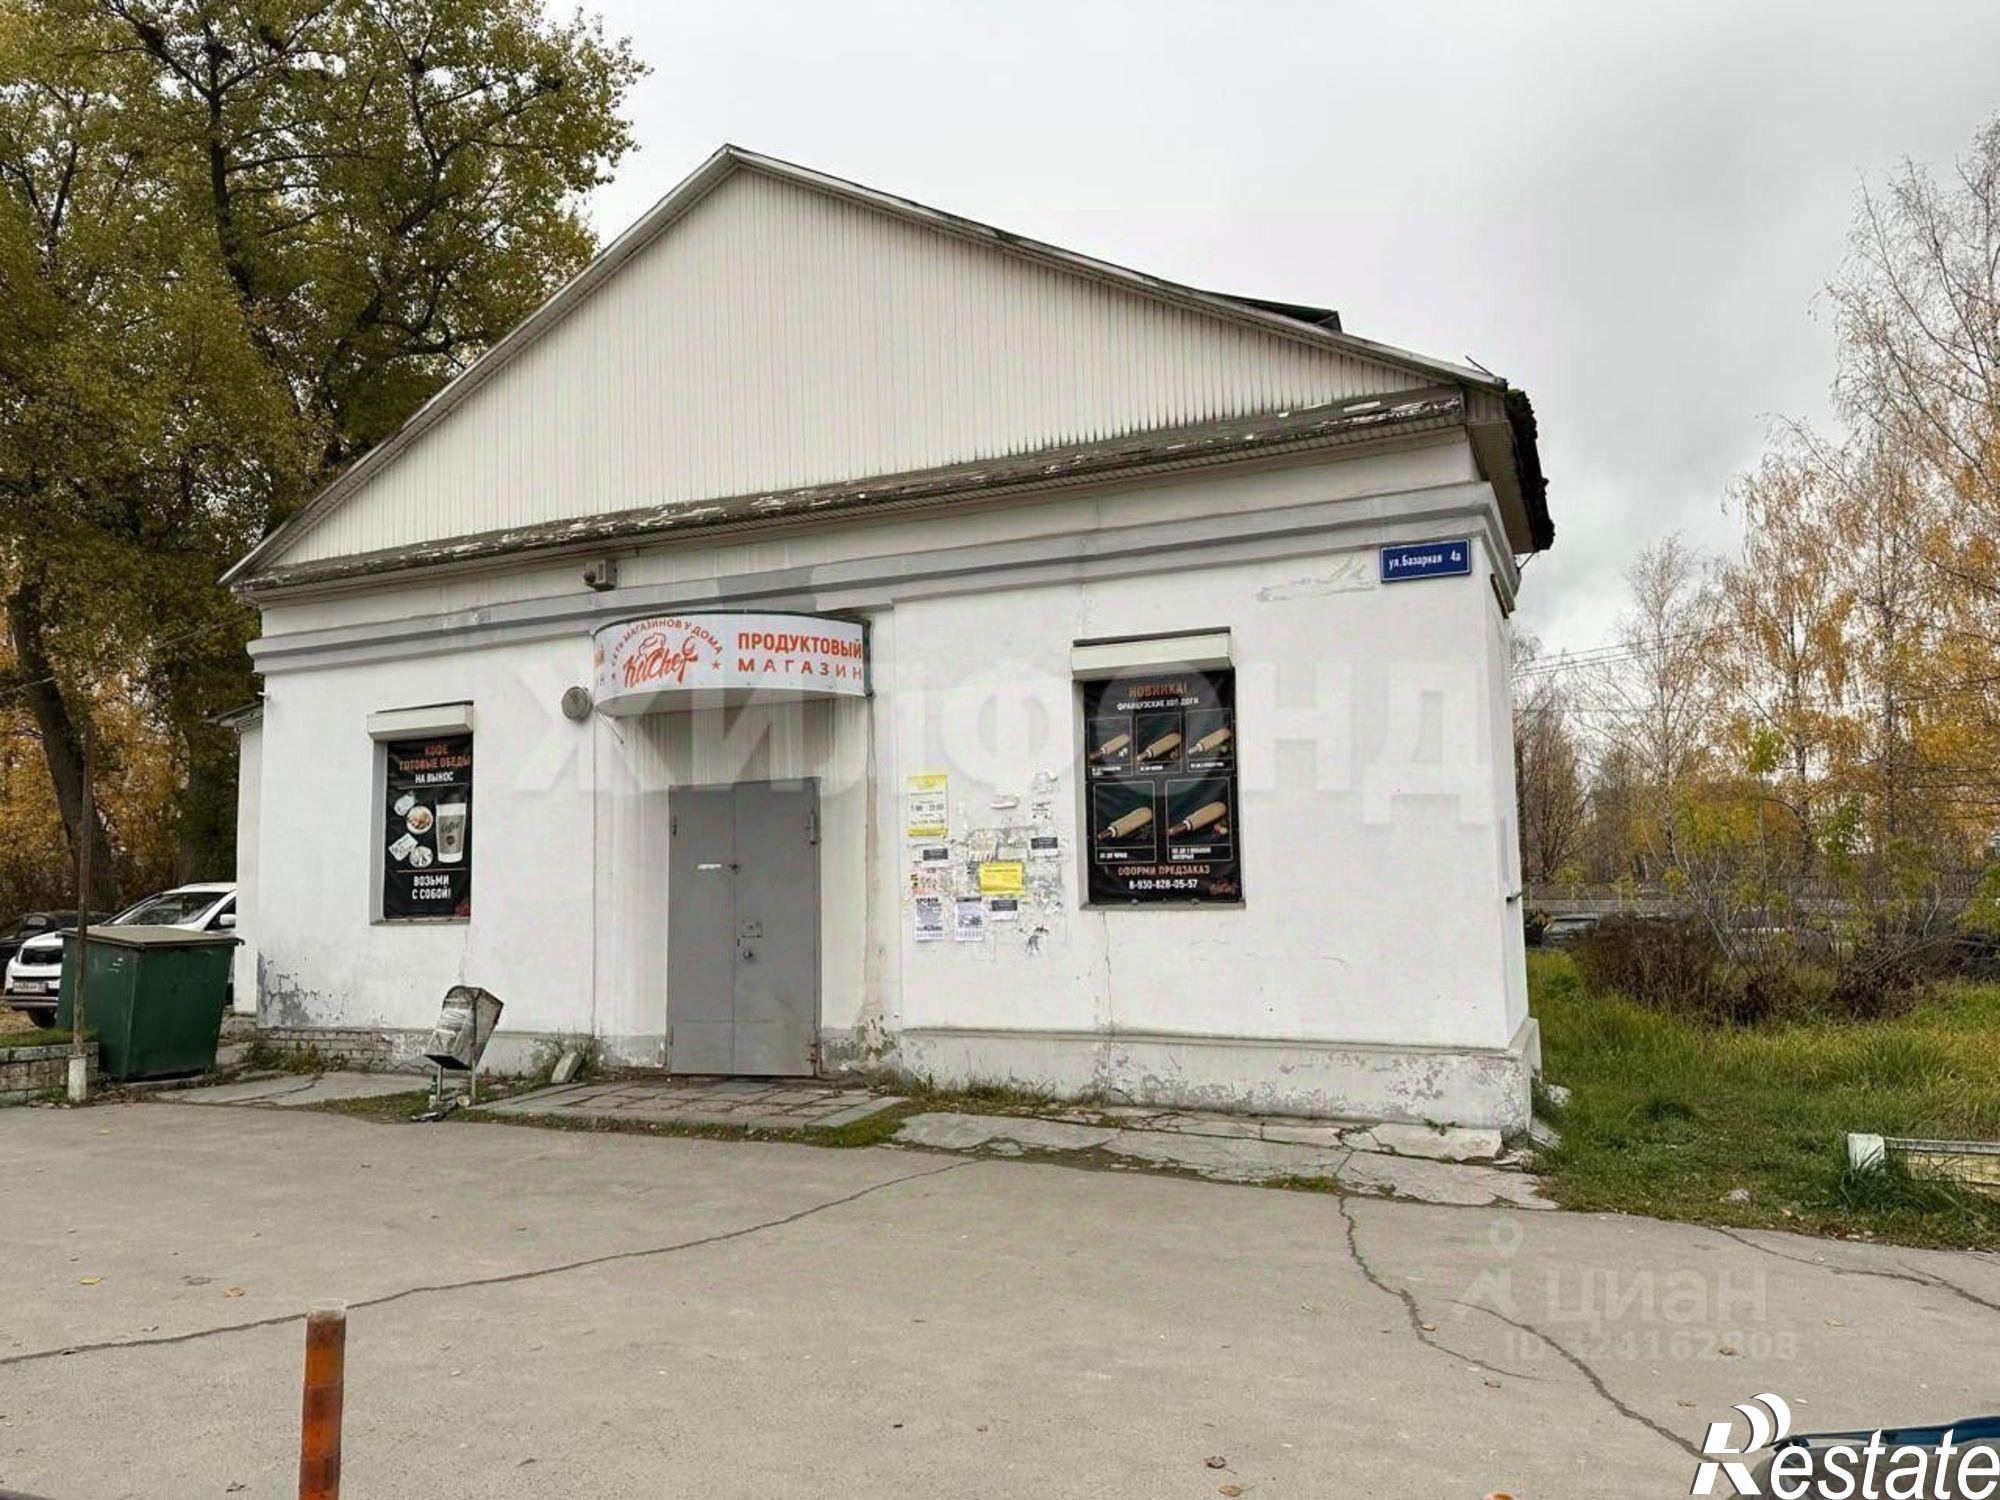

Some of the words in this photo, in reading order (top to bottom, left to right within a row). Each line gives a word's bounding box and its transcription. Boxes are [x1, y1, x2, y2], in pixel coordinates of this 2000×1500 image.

[692, 625, 723, 654] ДОМА
[738, 632, 862, 659] ПРОДУКТОВЫЙ
[738, 658, 862, 681] МАГАЗИН
[1118, 865, 1155, 876] ОФОРМИ
[1159, 864, 1210, 876] ПРЕДЗАКАЗ
[413, 874, 449, 887] ВОЗЬМИ
[412, 888, 418, 899] С
